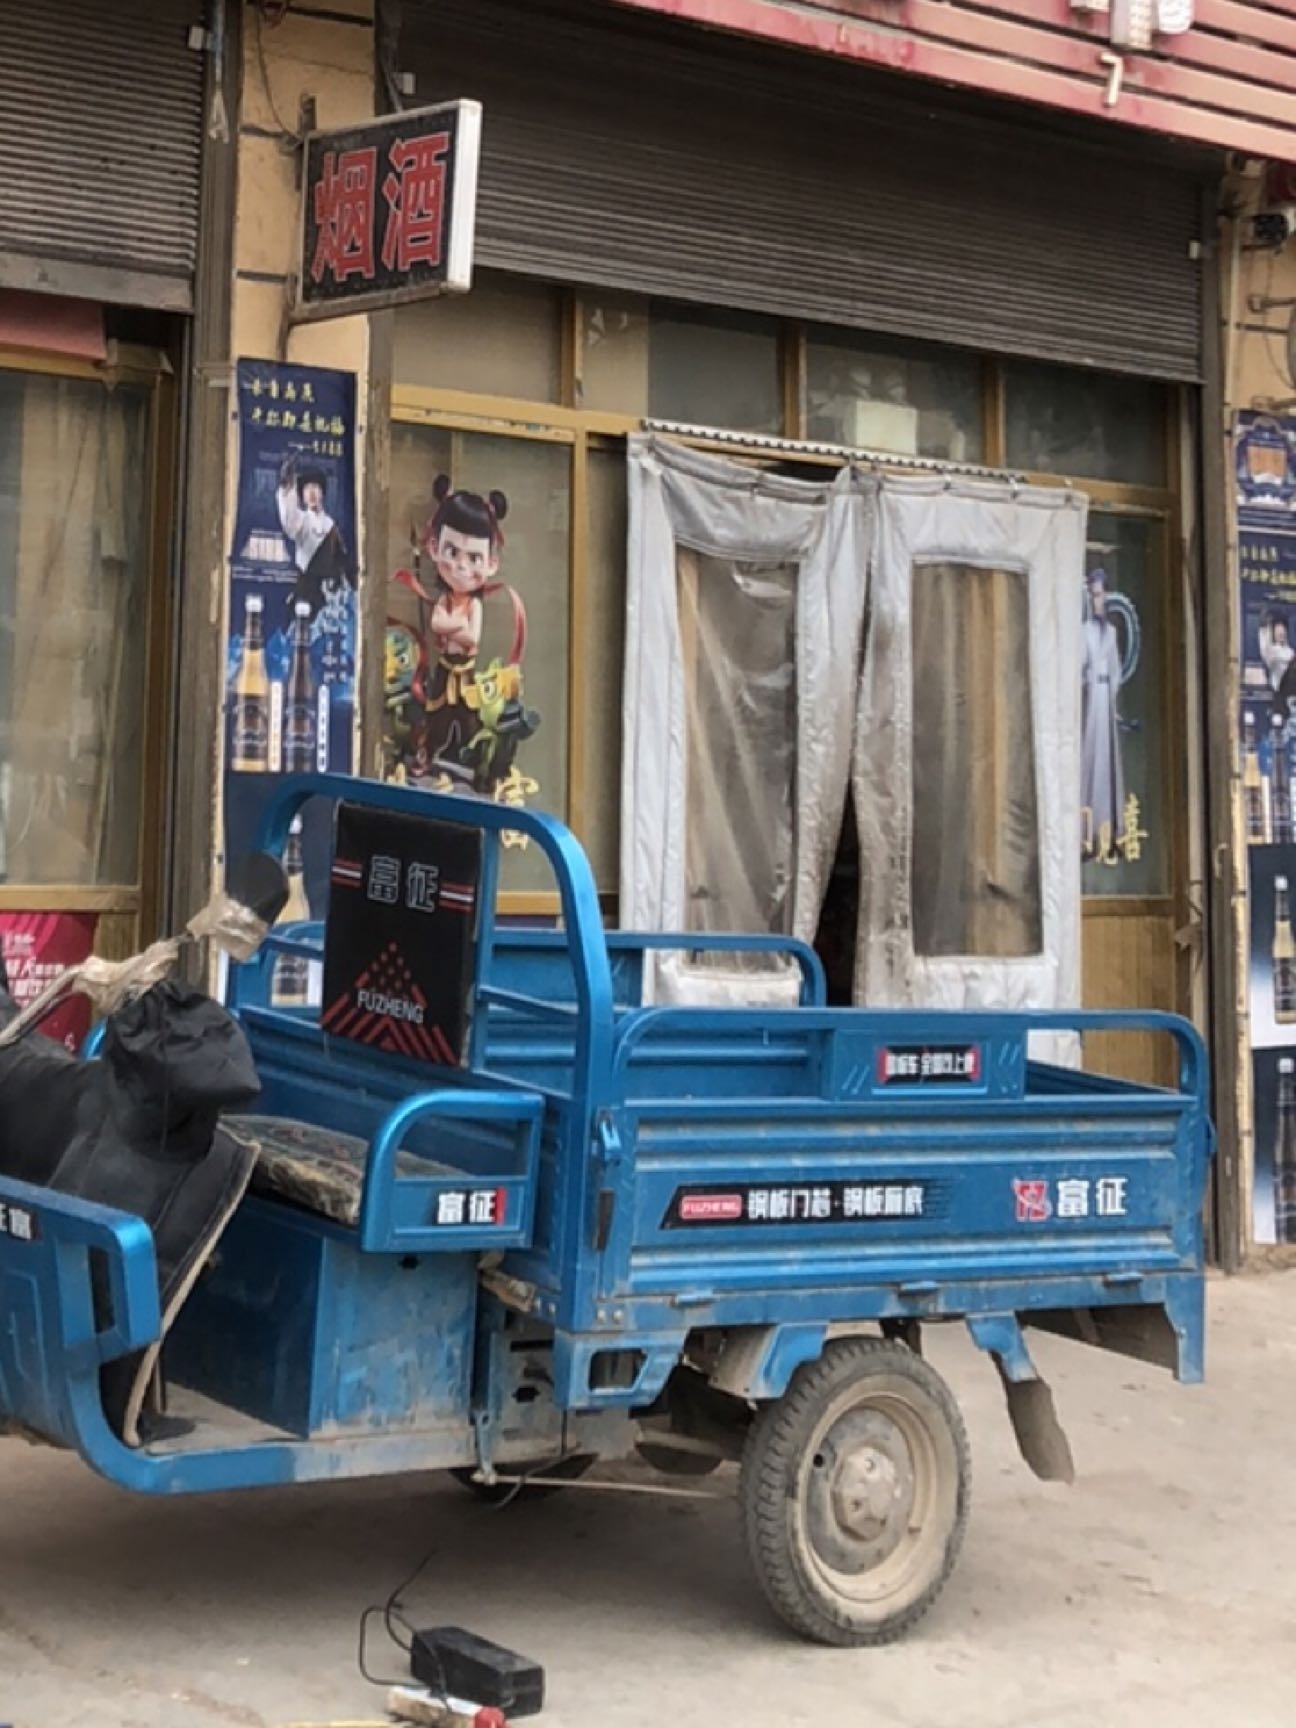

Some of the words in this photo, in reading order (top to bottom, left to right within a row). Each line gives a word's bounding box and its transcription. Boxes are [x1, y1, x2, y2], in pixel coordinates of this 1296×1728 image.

[311, 130, 451, 283] 烟酒
[366, 855, 439, 913] 富征
[357, 988, 424, 1024] FUZHENG
[437, 1189, 496, 1225] 富征
[1056, 1176, 1128, 1218] 富征
